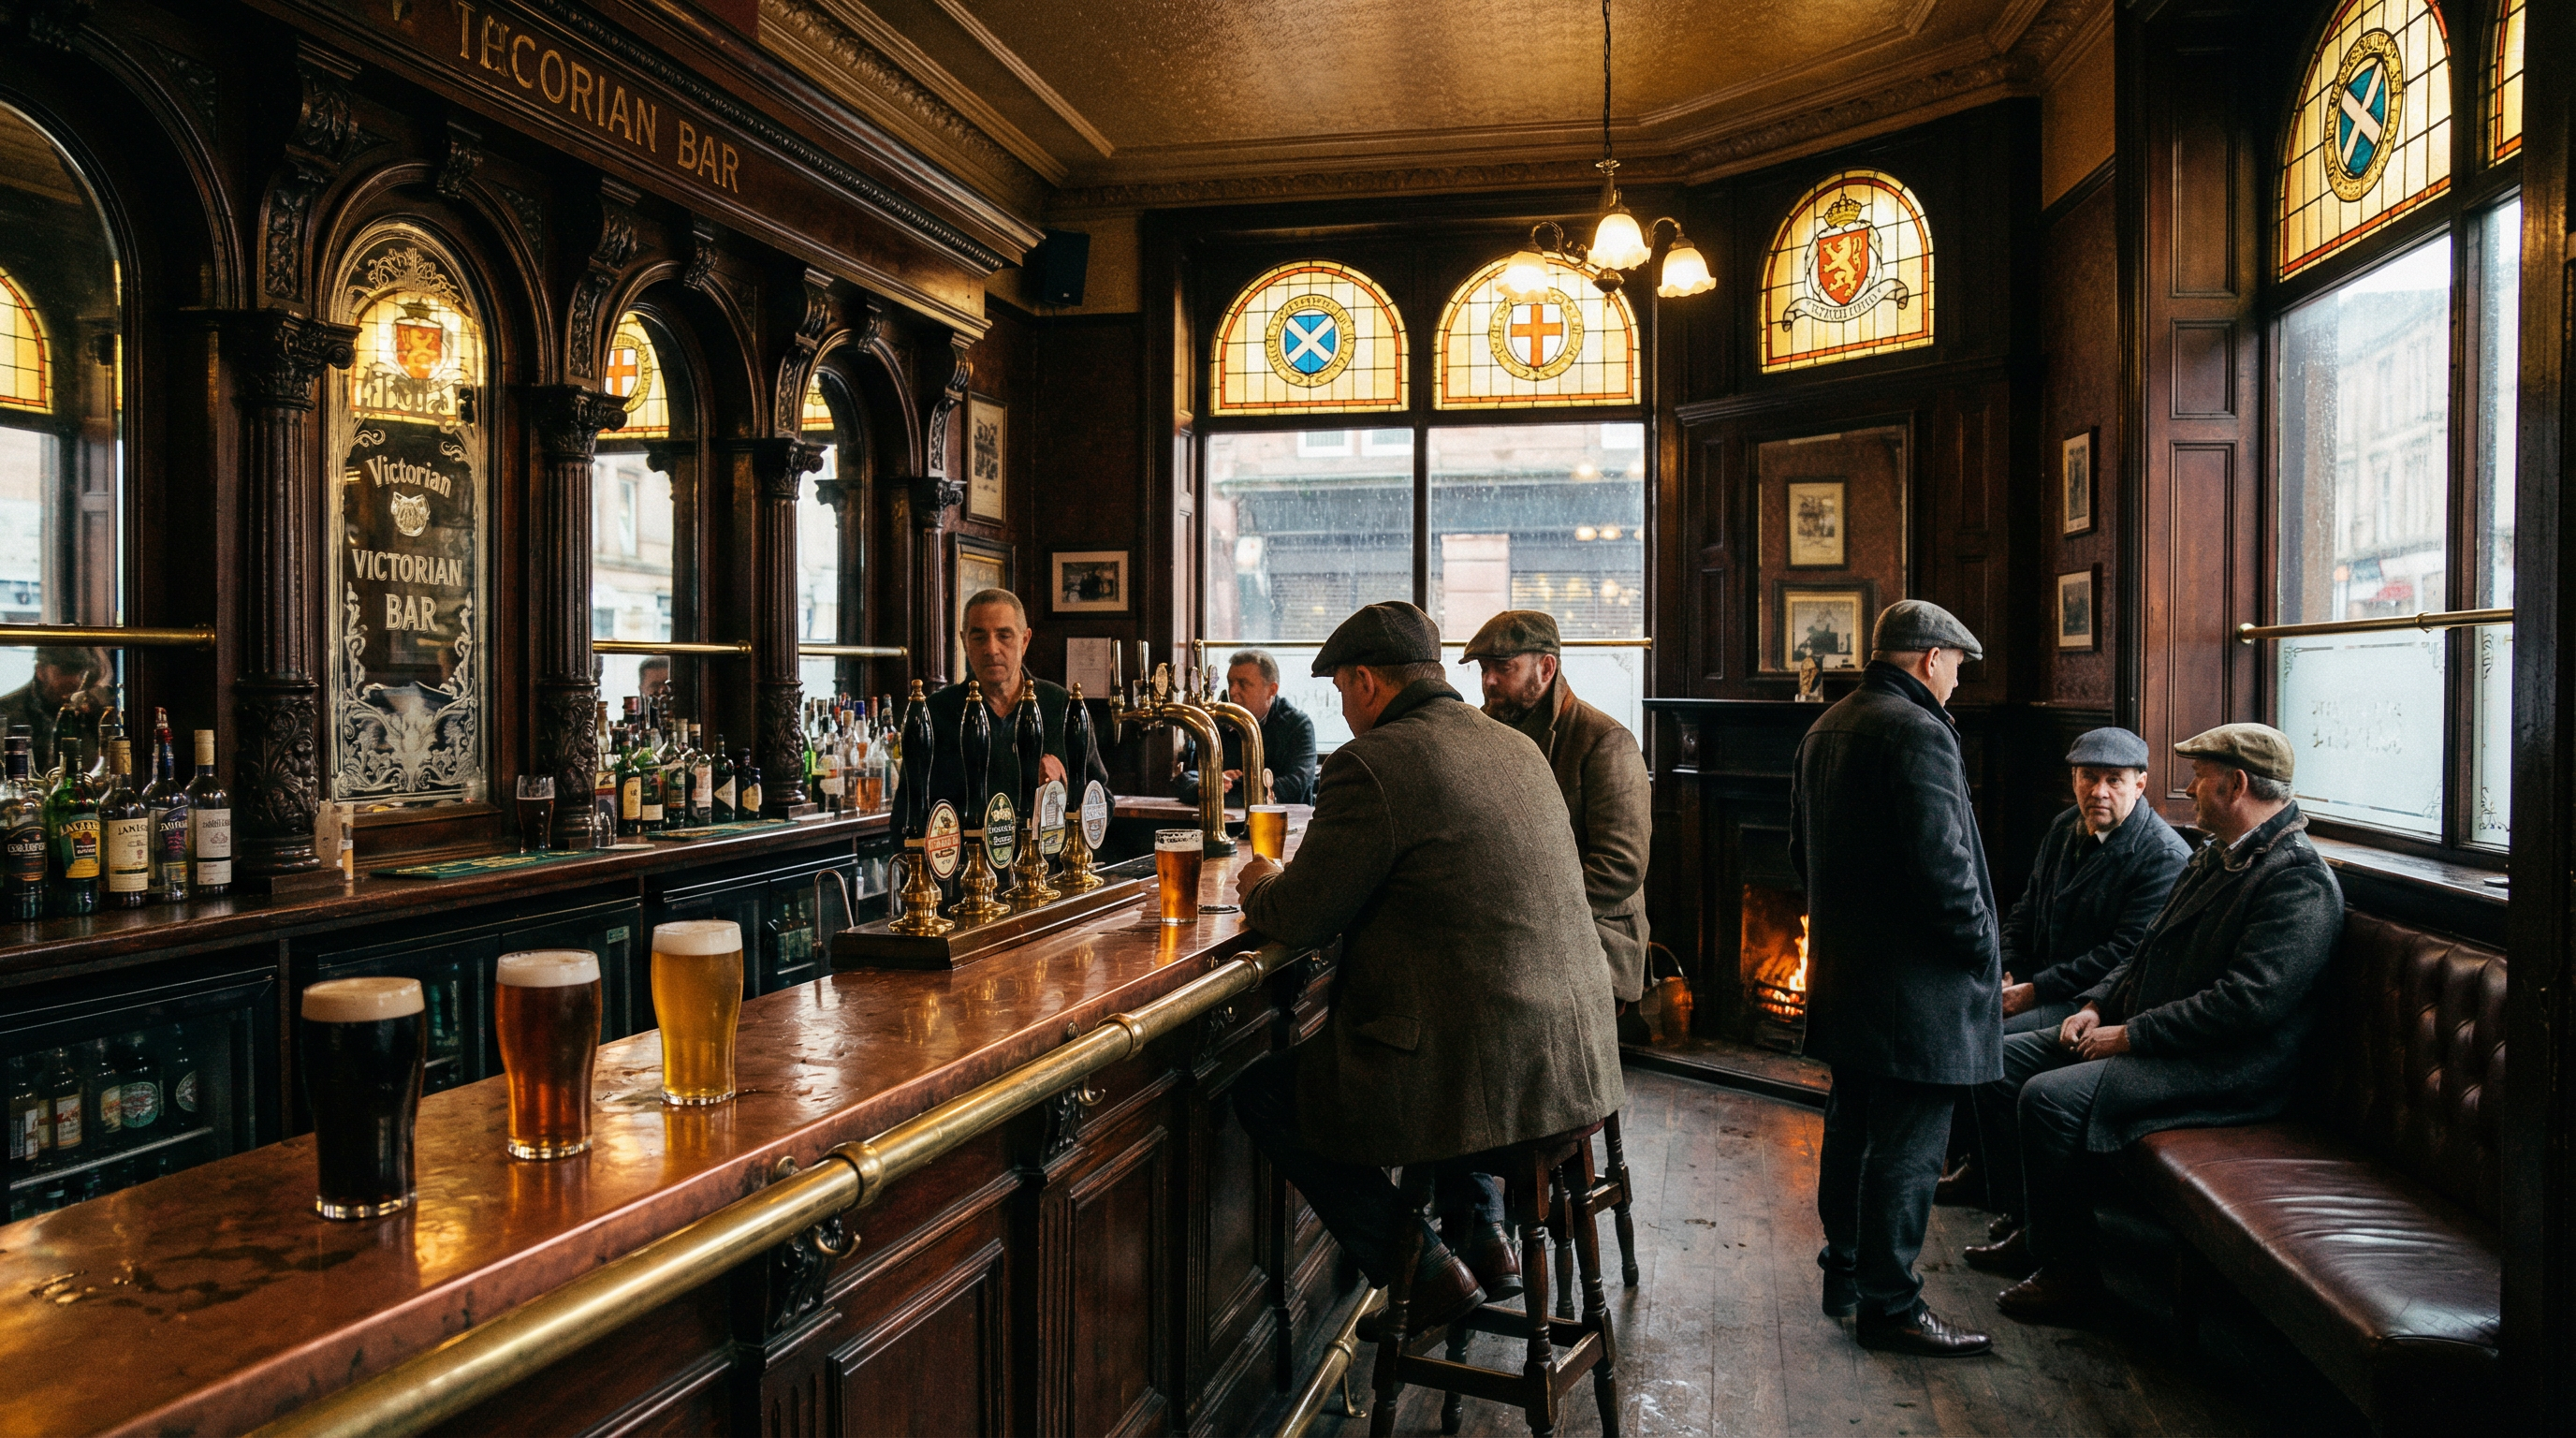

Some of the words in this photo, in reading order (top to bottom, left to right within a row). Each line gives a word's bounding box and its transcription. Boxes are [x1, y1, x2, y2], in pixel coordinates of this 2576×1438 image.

[677, 120, 739, 194] BAR
[365, 454, 452, 498] Victorian
[351, 549, 463, 587] VICTORIAN
[385, 593, 438, 633] BAR
